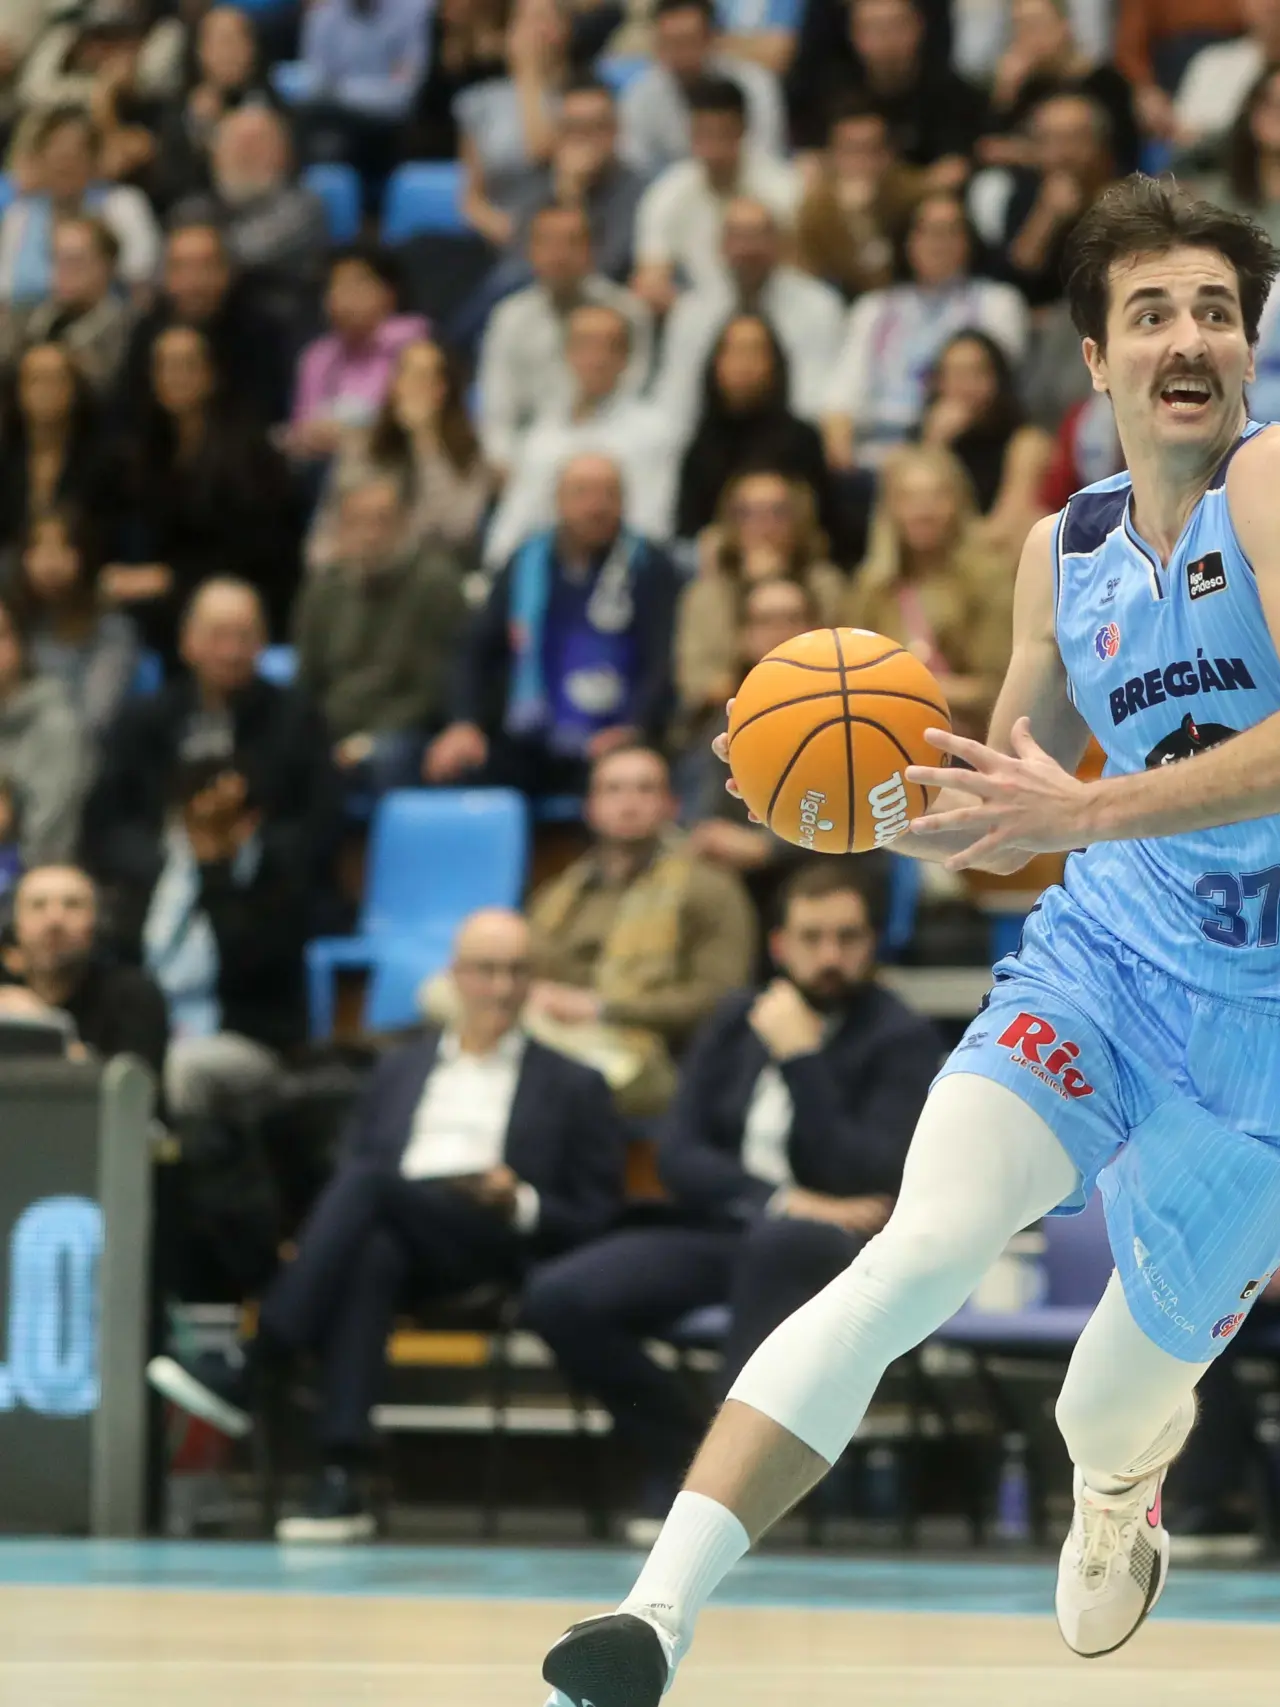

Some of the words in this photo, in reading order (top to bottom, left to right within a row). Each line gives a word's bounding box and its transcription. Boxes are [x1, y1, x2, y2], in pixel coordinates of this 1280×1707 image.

[1030, 1065, 1069, 1100] GALICIA
[1143, 1261, 1179, 1307] XUNTA
[1152, 1290, 1195, 1335] GALICIA
